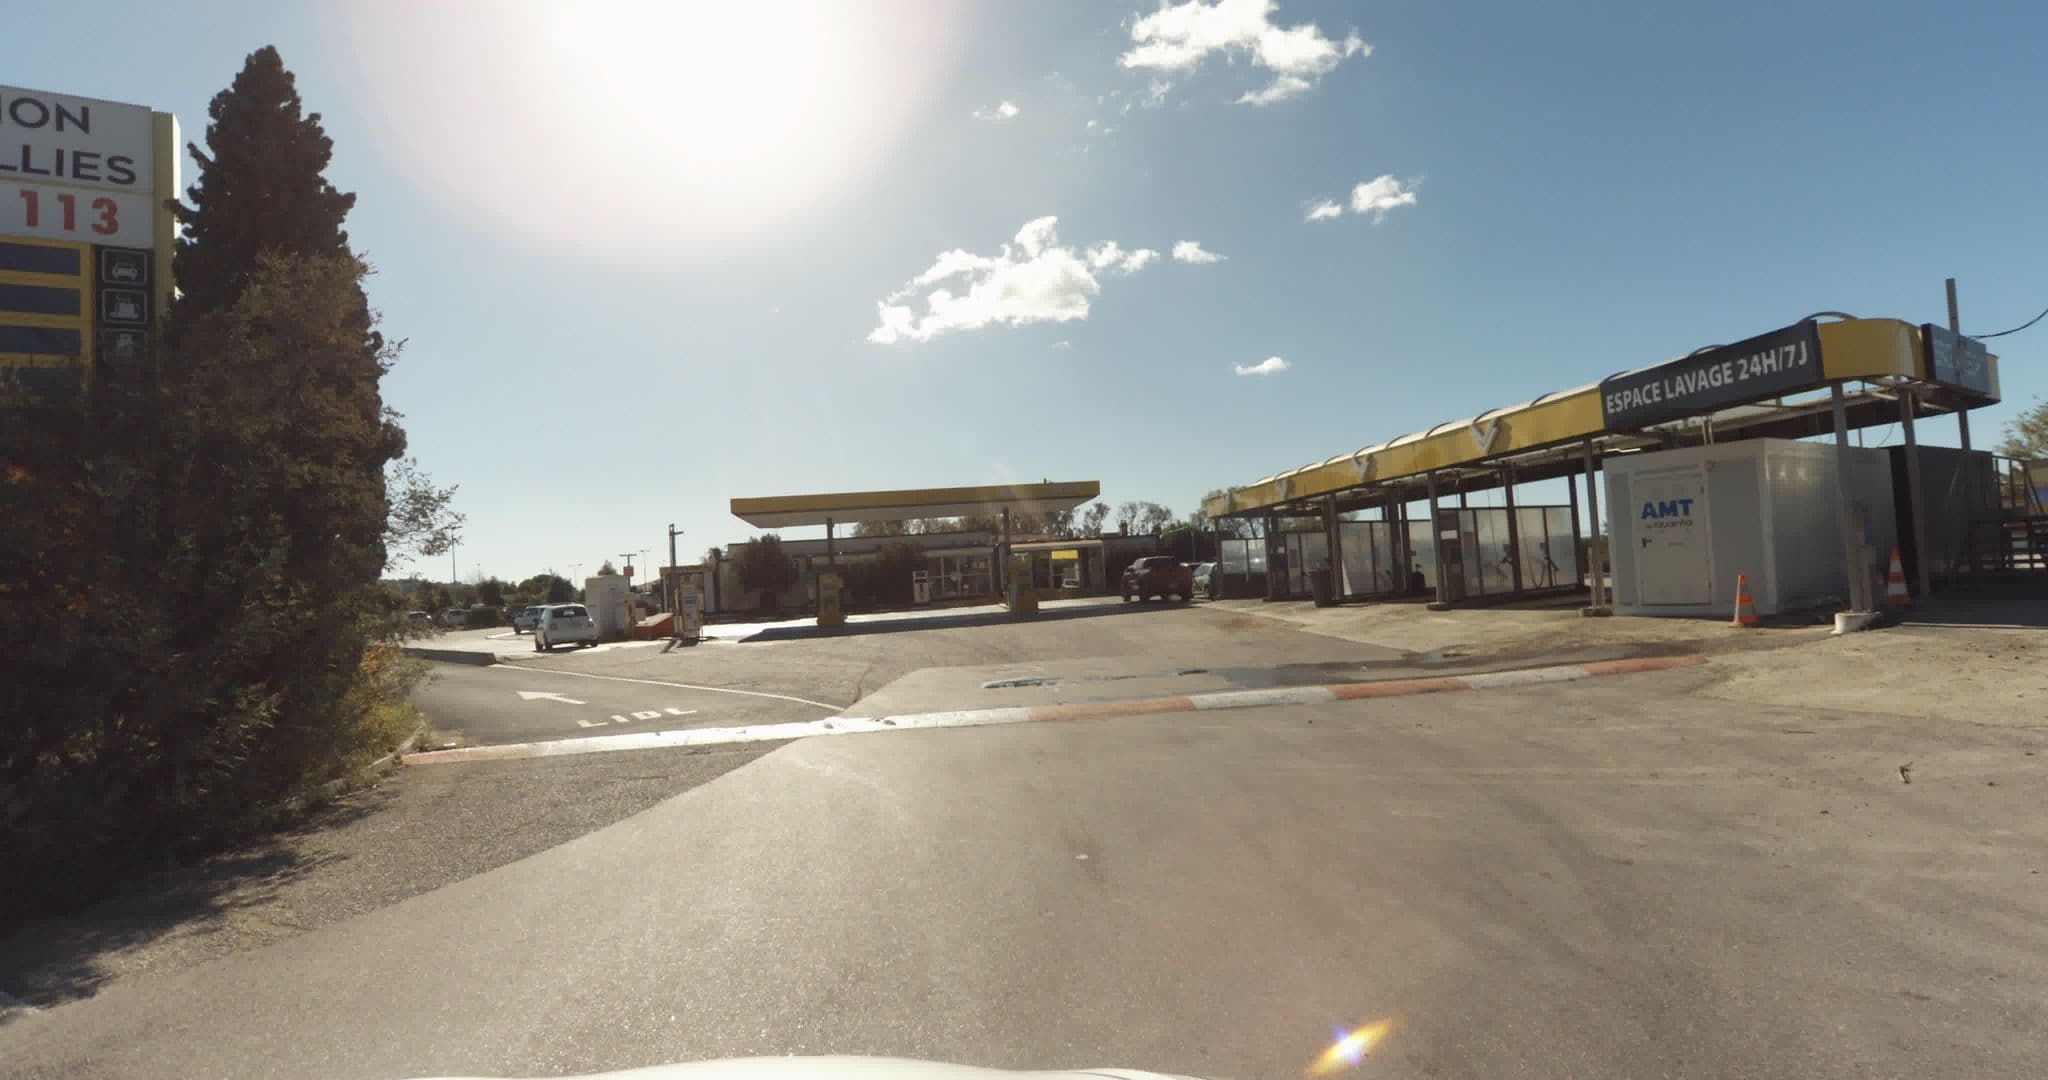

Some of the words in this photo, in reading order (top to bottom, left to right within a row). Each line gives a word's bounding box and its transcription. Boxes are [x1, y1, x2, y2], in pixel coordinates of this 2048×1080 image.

[0, 95, 90, 134] ON
[1606, 382, 1662, 414] ESPACE
[1664, 361, 1734, 398] LAVAGE
[1738, 340, 1808, 381] 24H/7J
[1641, 499, 1694, 519] AMT
[576, 707, 697, 728] LIDL
